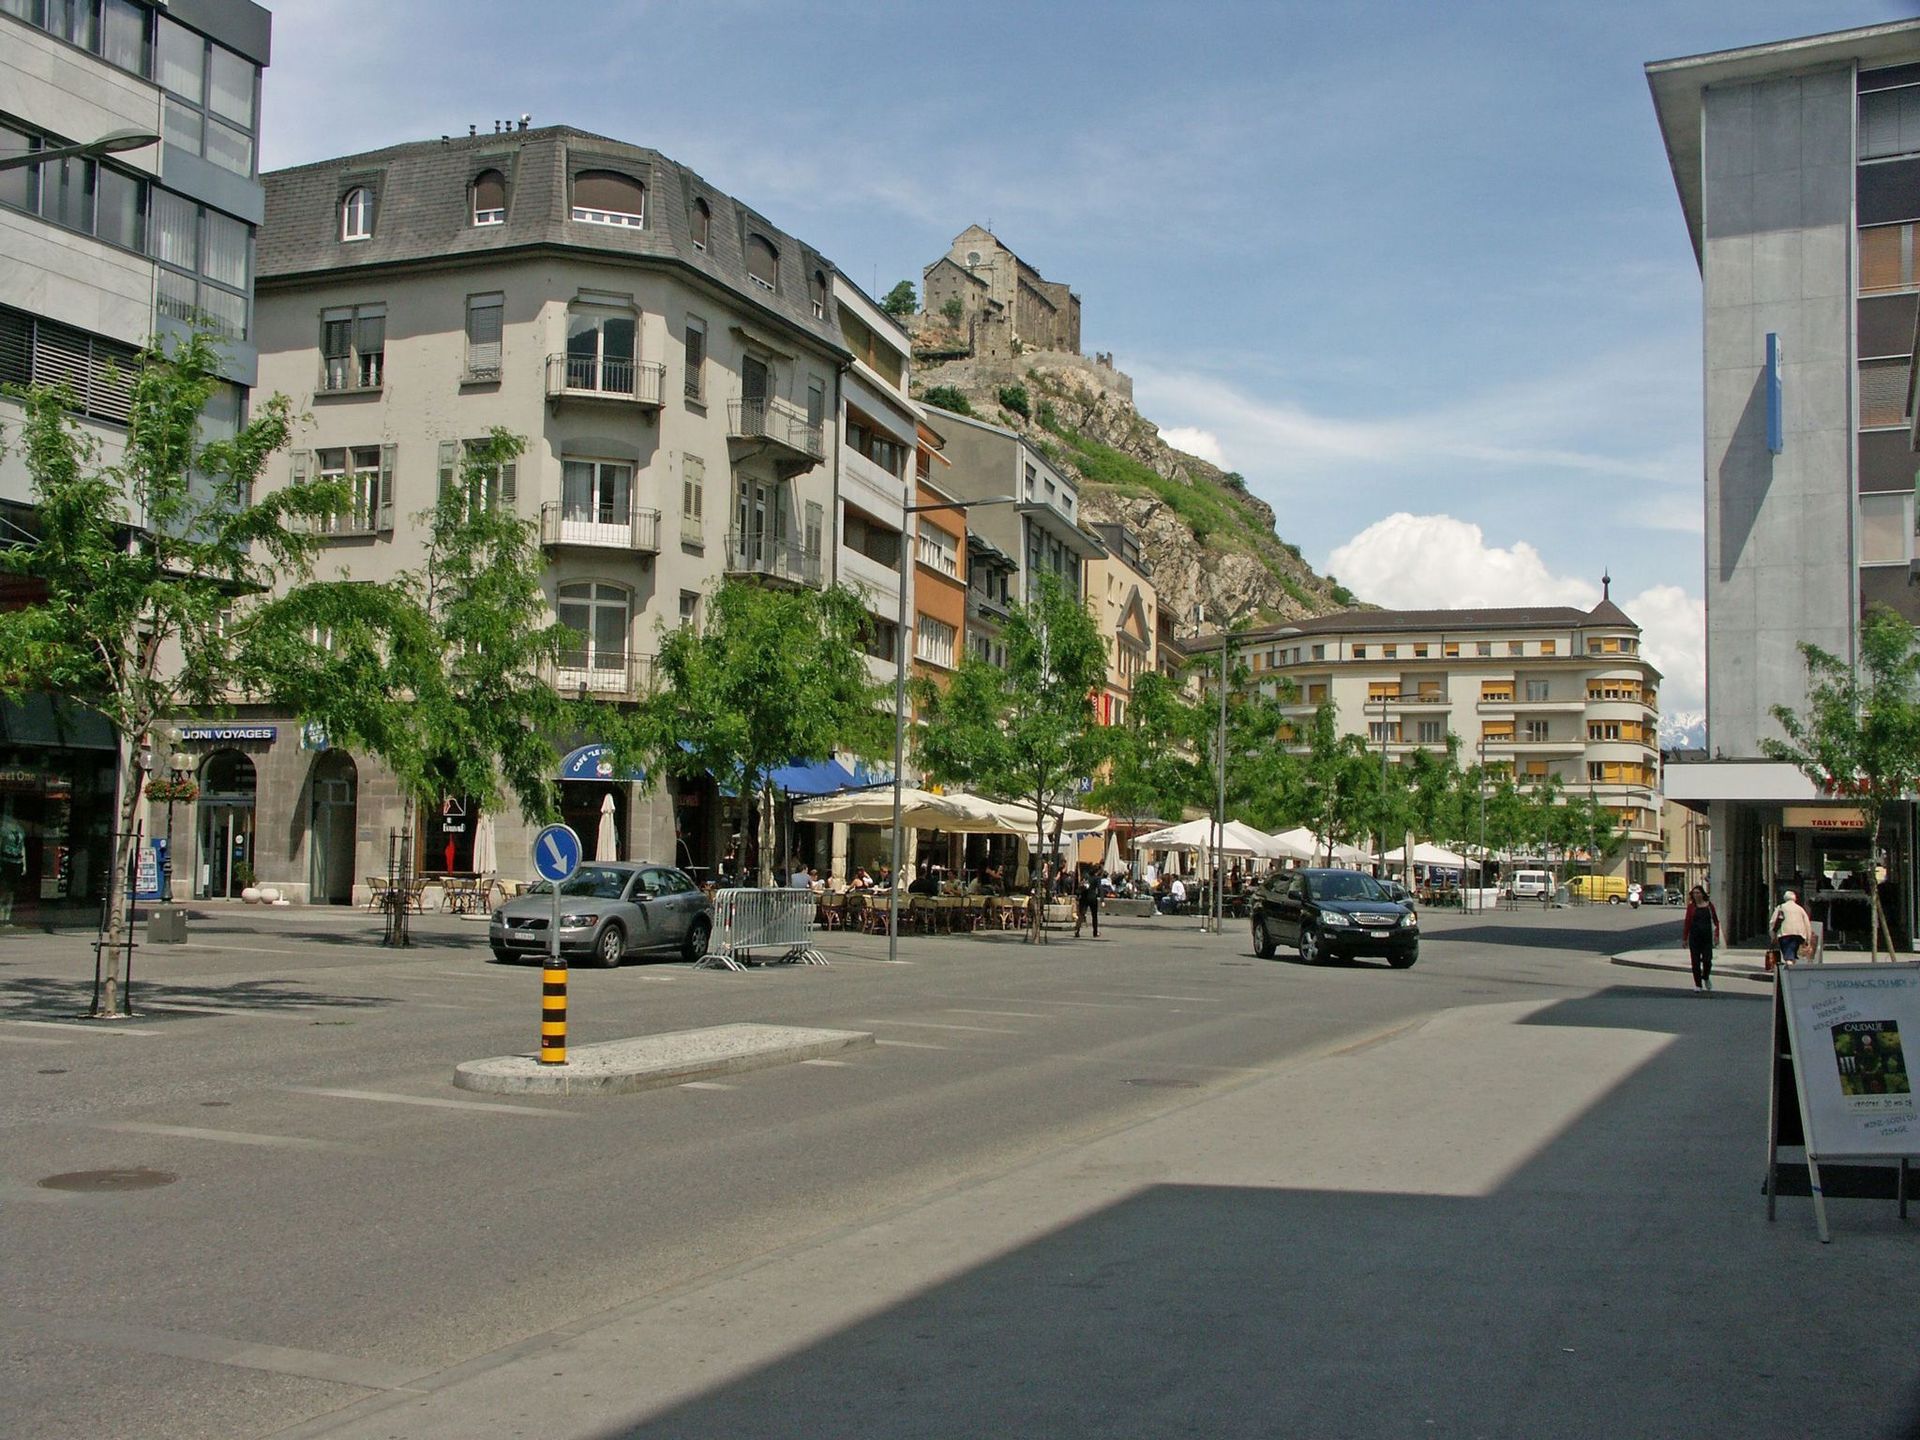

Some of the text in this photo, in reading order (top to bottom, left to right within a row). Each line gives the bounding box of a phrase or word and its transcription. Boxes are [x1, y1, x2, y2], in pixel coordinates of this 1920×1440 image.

[182, 729, 271, 740] UONI VOYAGES
[572, 753, 589, 772] CAFÉ
[1811, 819, 1838, 827] TALLY
